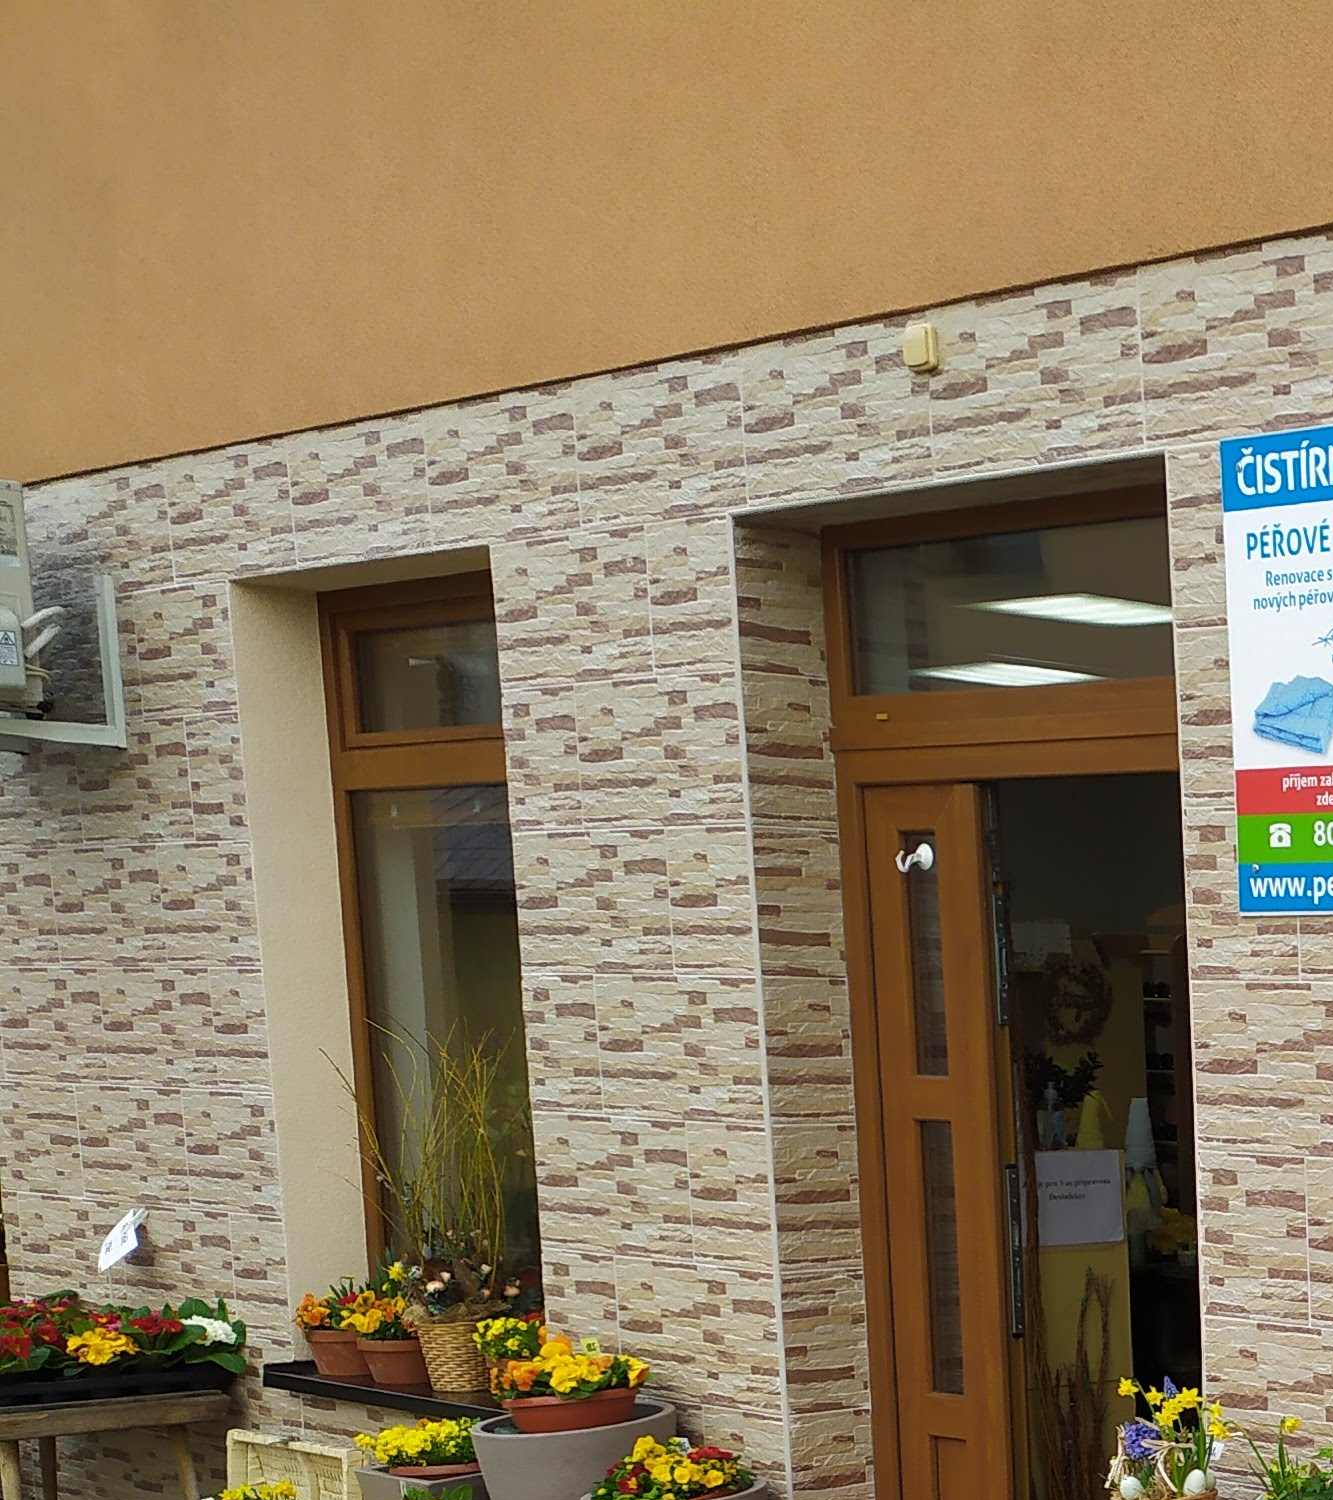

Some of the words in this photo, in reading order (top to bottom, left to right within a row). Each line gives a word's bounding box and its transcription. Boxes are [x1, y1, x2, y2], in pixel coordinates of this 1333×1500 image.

[1246, 518, 1331, 560] PÉŘOVÉ
[1265, 569, 1325, 587] Renovace
[1253, 591, 1297, 613] nových
[1282, 773, 1318, 792] příjem
